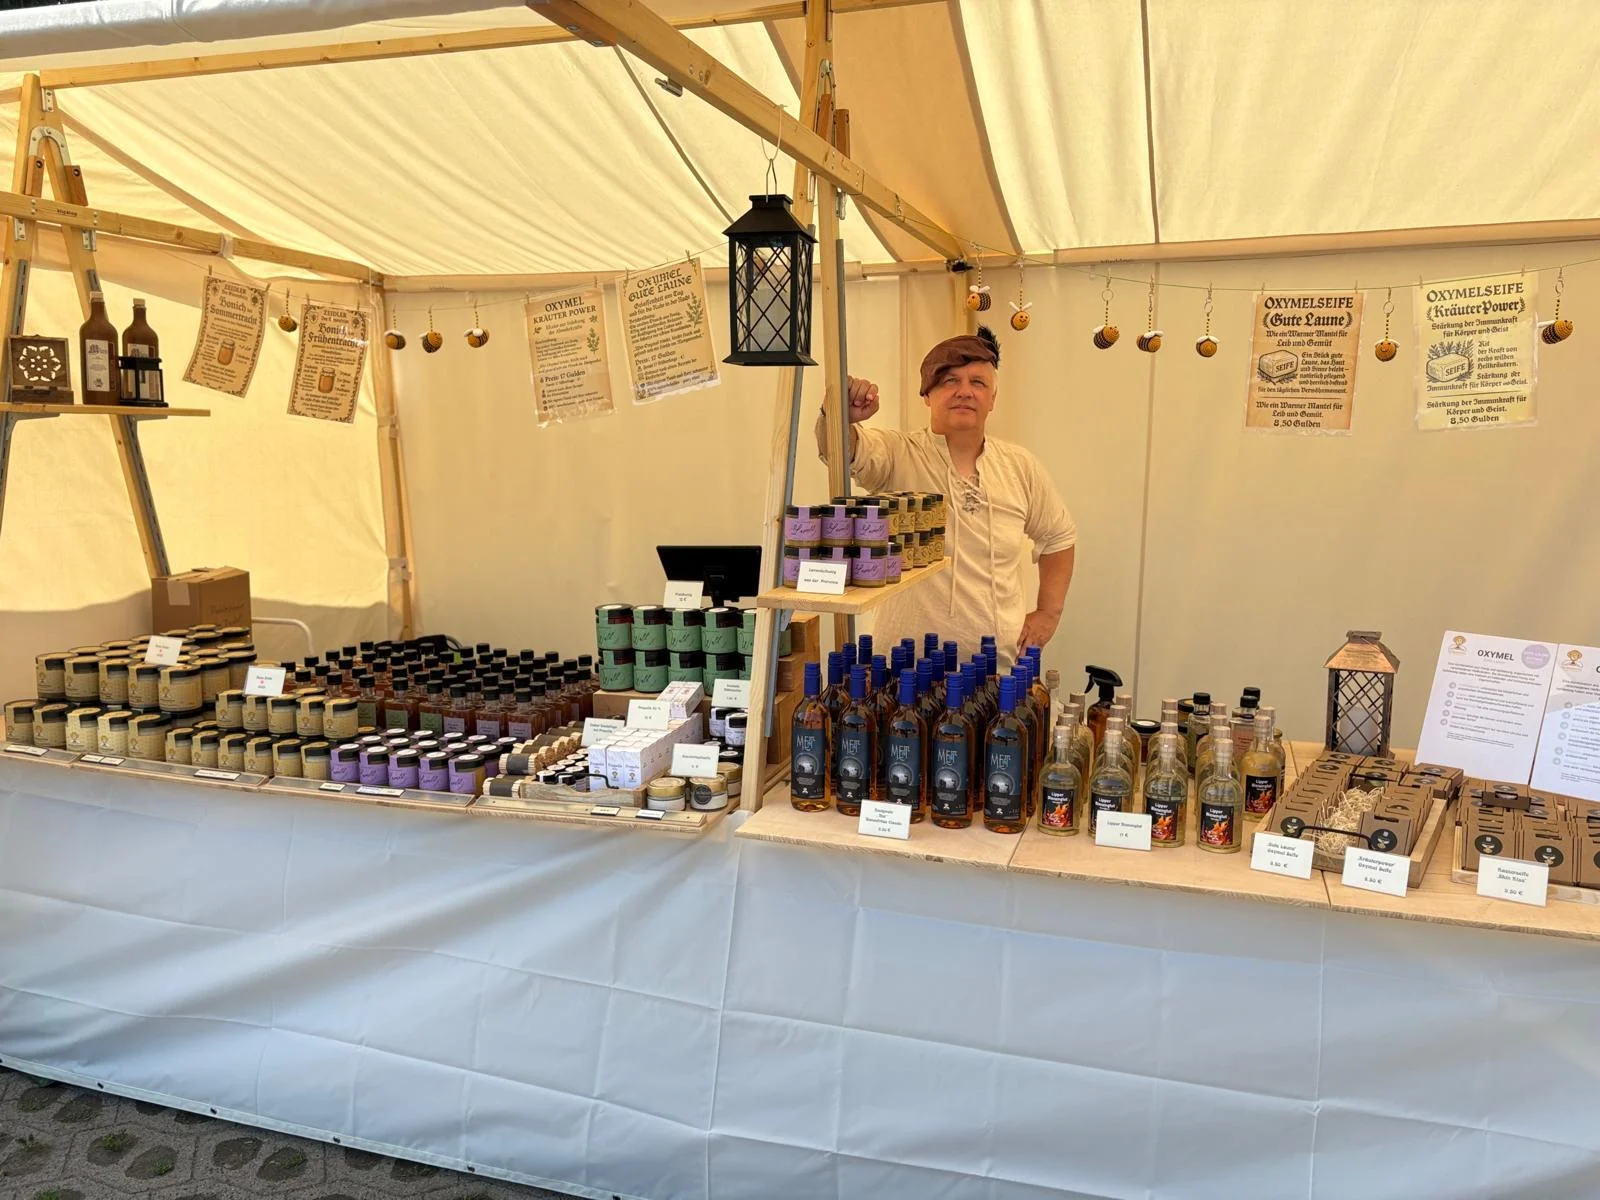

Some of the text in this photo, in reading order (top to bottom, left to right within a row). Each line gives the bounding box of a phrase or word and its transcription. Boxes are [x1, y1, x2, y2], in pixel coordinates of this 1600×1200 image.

[636, 267, 681, 290] OXYMEL
[627, 275, 692, 302] GUTE LAUNE
[1427, 282, 1524, 302] OXYMELSEIFE
[545, 296, 584, 312] OXYMEL
[1264, 297, 1354, 309] OXYMELSEIFE
[533, 304, 596, 324] KRÄUTER POWER
[1270, 312, 1344, 326] Gute Laune
[1275, 361, 1294, 372] SEIFE
[1445, 363, 1466, 376] SEIFE
[1257, 401, 1269, 409] Wie
[1333, 403, 1343, 411] für
[1293, 420, 1321, 428] Gulden
[1471, 415, 1499, 423] Gulden
[1478, 650, 1515, 661] OXYMEL
